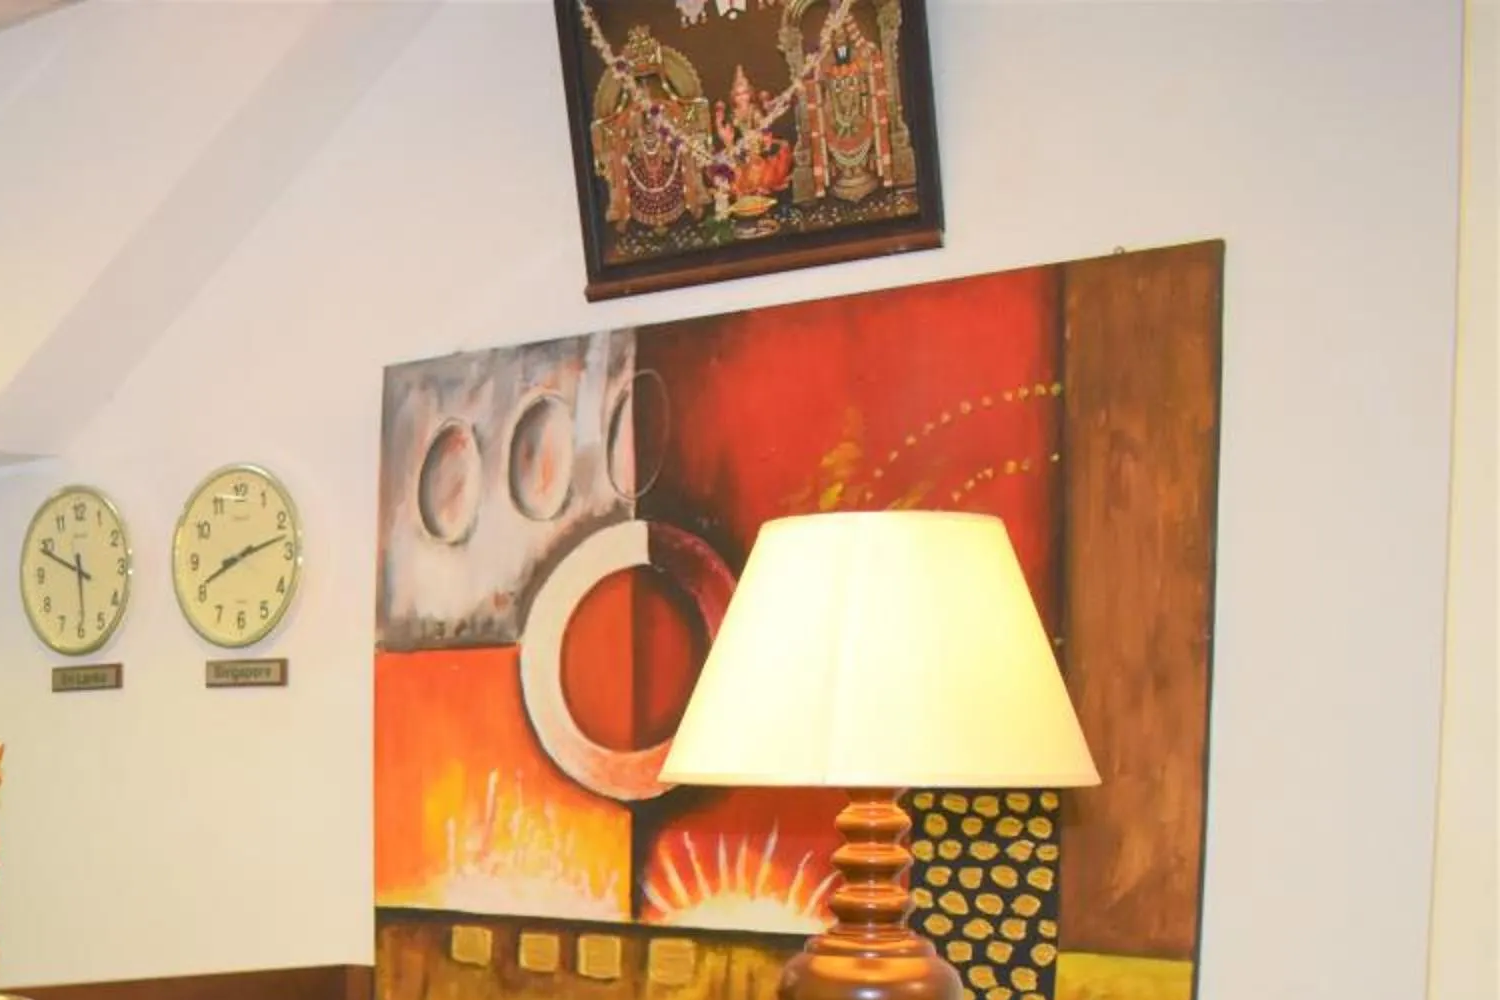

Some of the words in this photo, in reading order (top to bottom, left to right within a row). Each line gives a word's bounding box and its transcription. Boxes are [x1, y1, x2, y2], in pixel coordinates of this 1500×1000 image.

[73, 502, 87, 521] 12
[213, 496, 224, 515] 11
[56, 515, 65, 532] 11
[276, 511, 287, 530] 2
[110, 530, 120, 547] 2
[196, 521, 210, 540] 10
[284, 542, 293, 561] 3
[116, 558, 125, 575] 3
[190, 552, 199, 572] 9
[198, 583, 207, 603] 8
[276, 576, 285, 595] 4
[43, 597, 51, 613] 8
[110, 590, 119, 607] 4
[215, 605, 224, 624] 7
[259, 601, 269, 620] 5
[57, 616, 66, 632] 7
[96, 612, 105, 630] 5
[237, 611, 245, 630] 6
